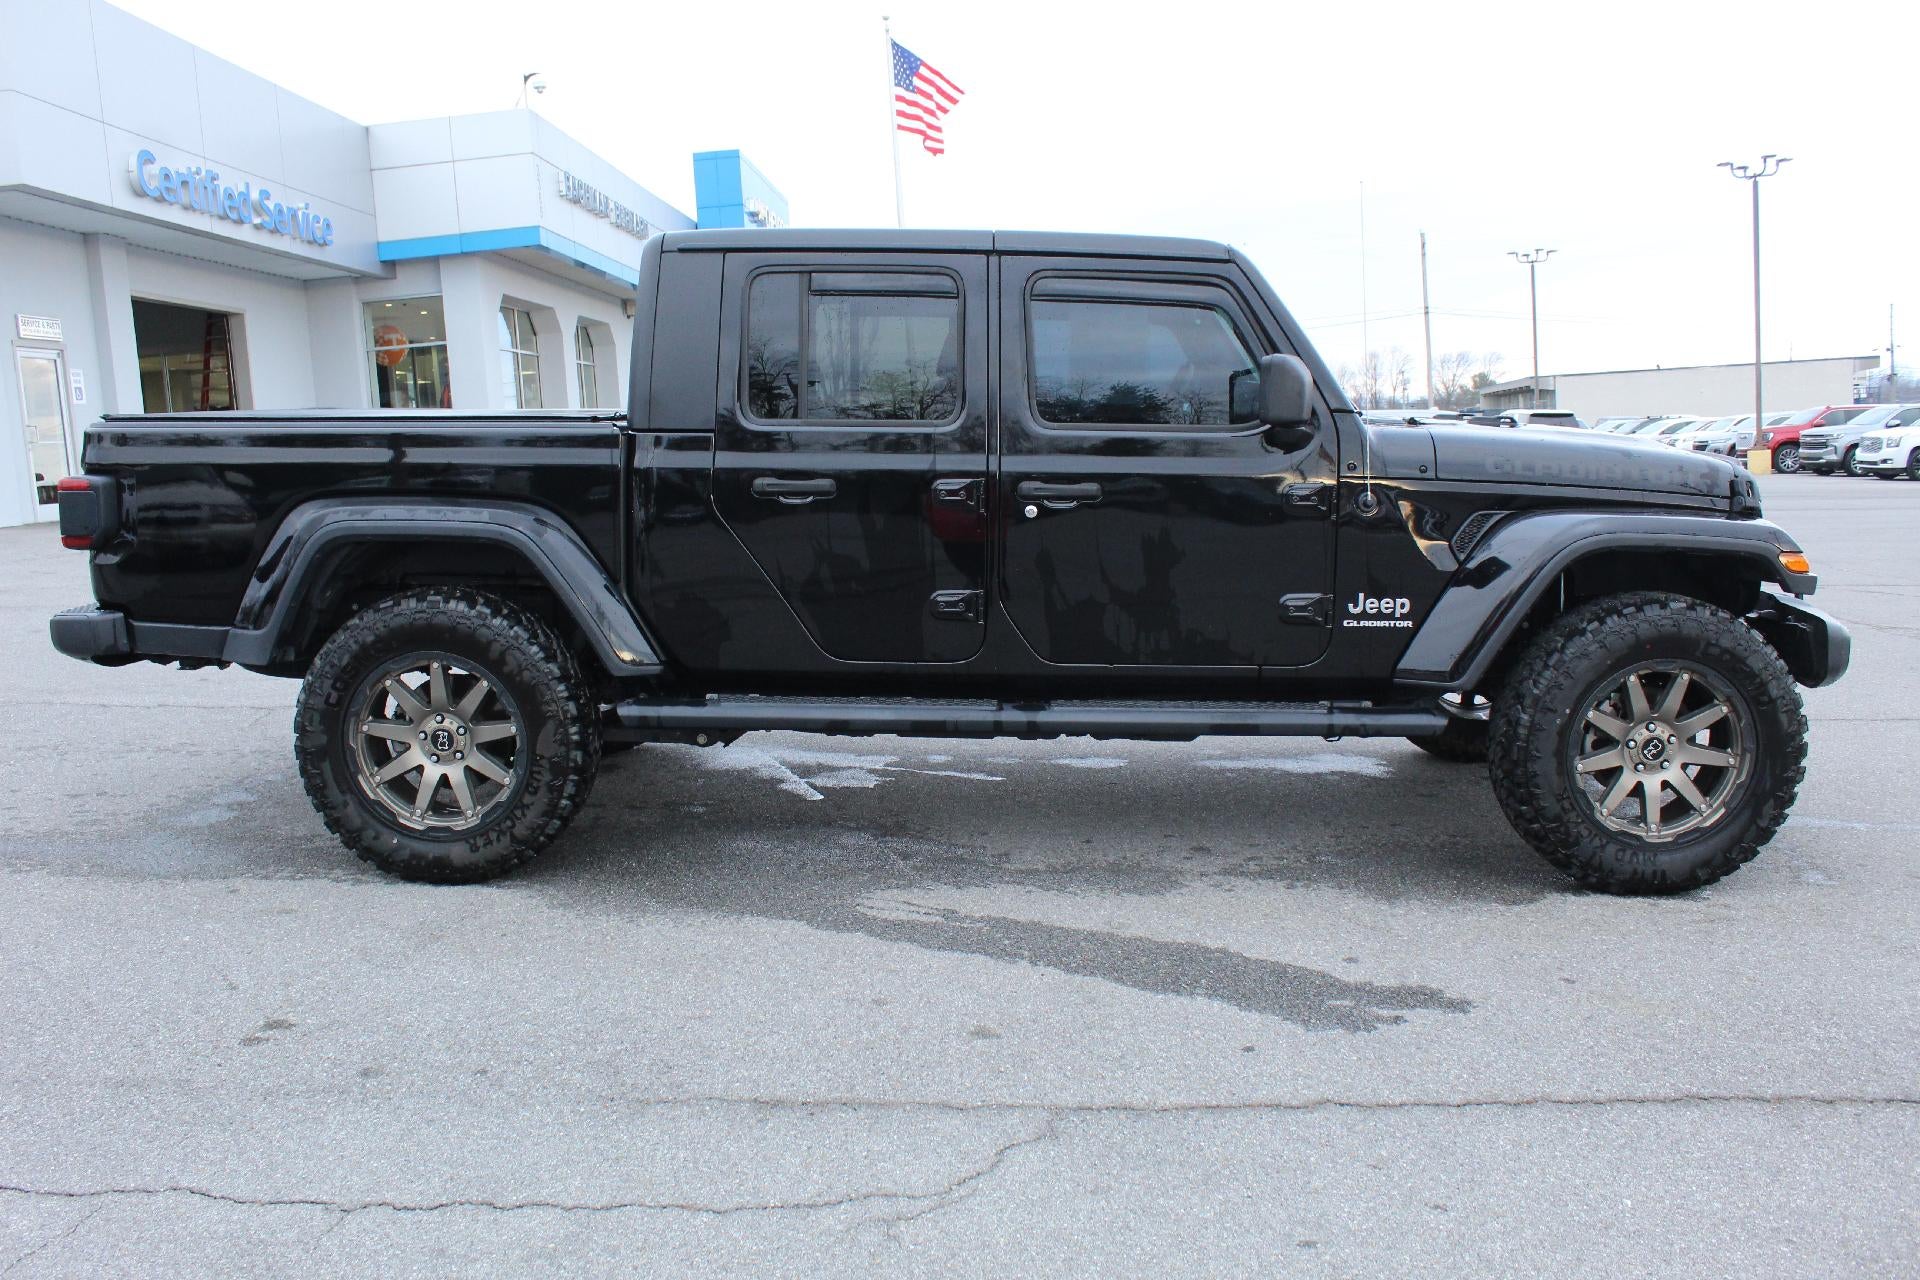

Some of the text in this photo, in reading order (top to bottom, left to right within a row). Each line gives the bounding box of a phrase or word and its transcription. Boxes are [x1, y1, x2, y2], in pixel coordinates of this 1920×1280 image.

[131, 149, 334, 246] Certified Service
[1348, 593, 1411, 618] Jeep
[1343, 620, 1413, 628] GLADIATOR
